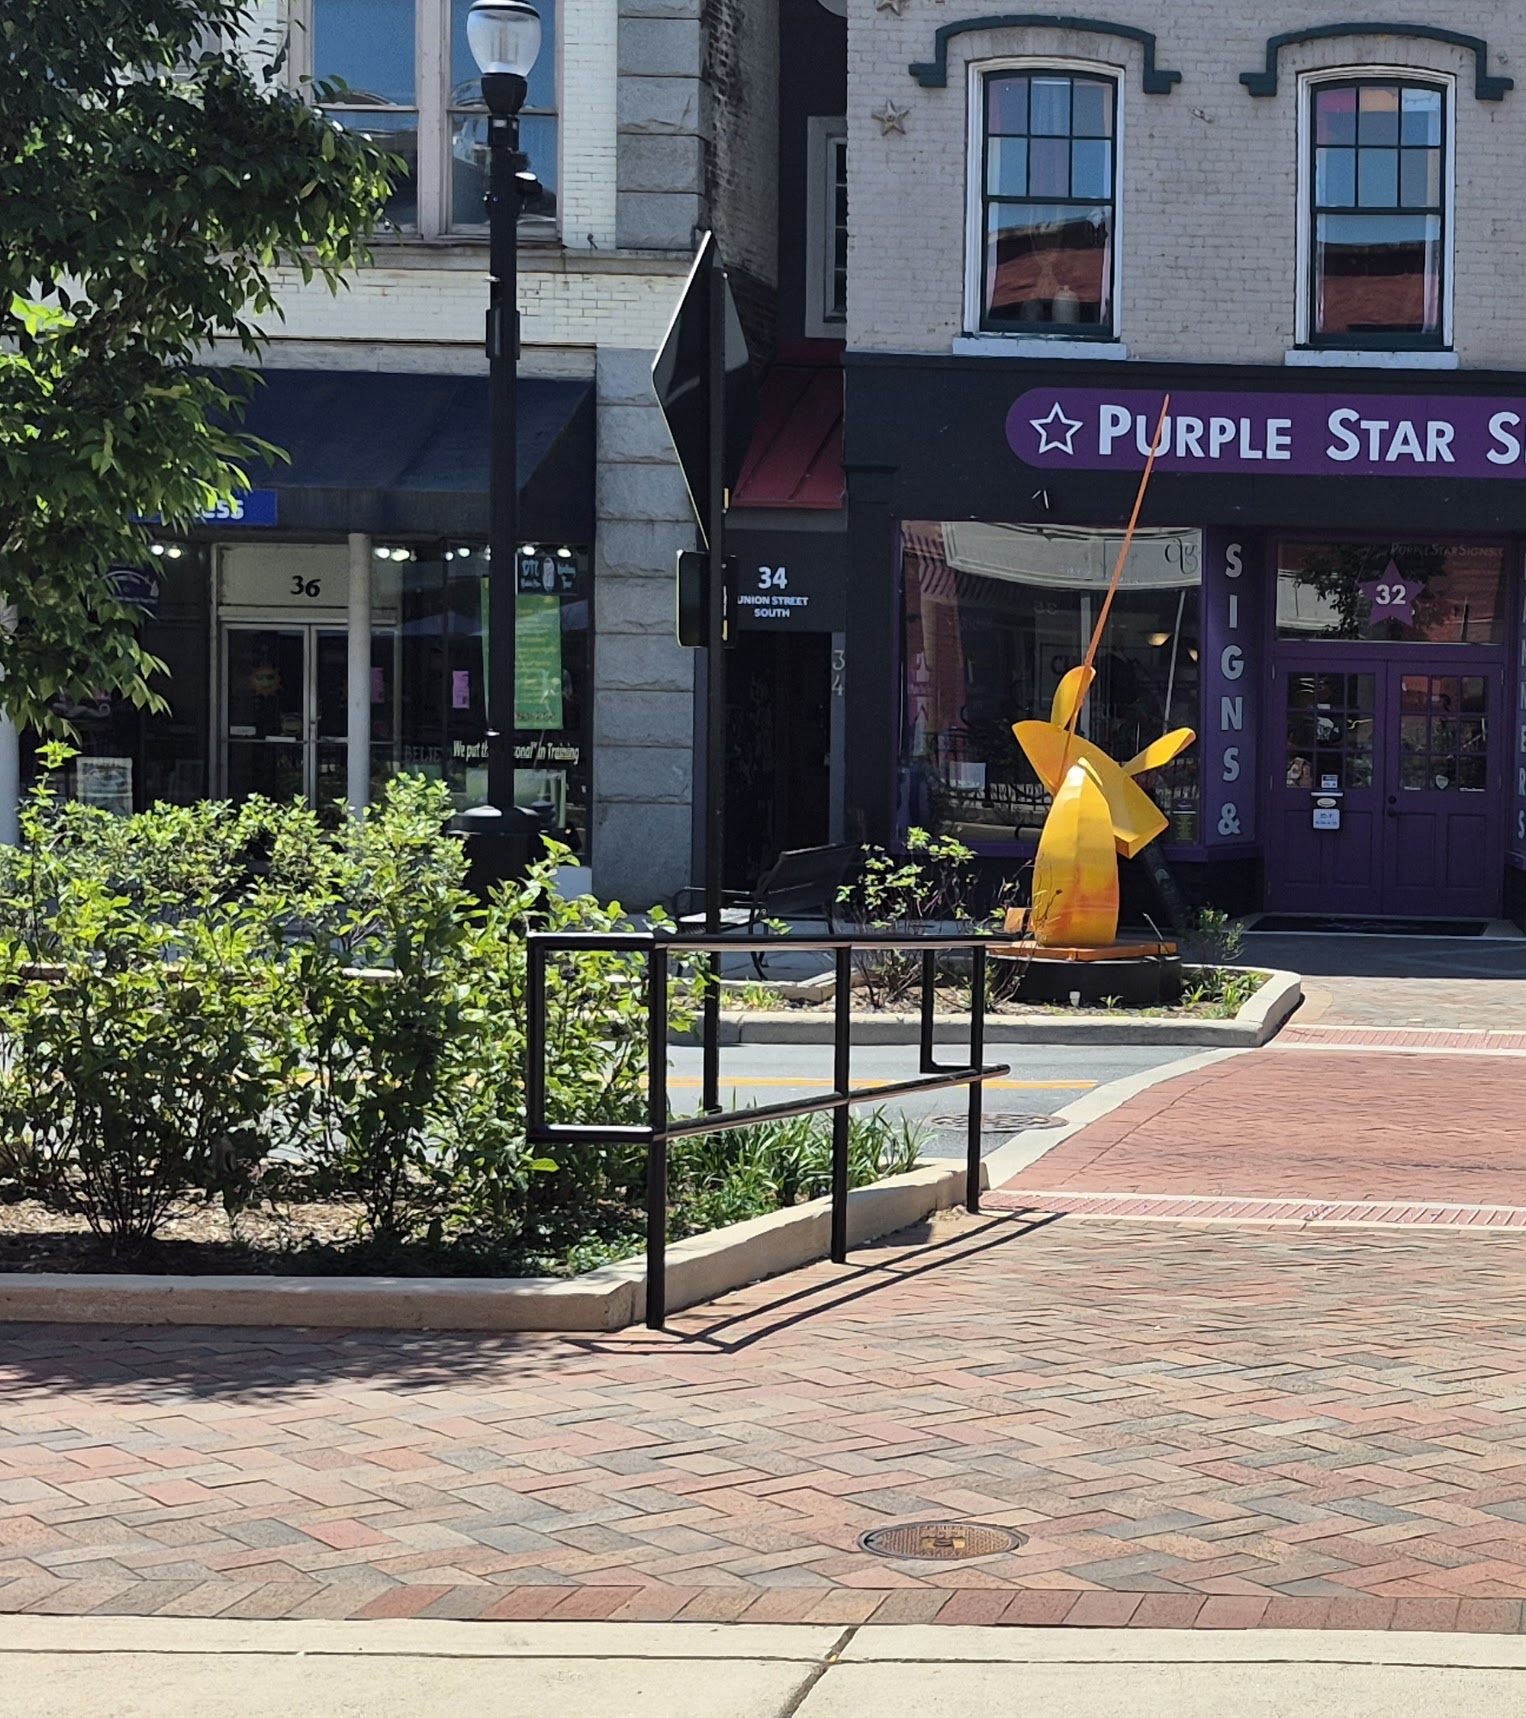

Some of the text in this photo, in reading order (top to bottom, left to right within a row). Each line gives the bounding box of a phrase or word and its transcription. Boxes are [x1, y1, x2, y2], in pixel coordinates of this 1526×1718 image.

[1099, 404, 1292, 460] PURPLE
[1326, 408, 1456, 463] STAR
[290, 575, 321, 598] 36
[758, 566, 788, 590] 34
[737, 595, 809, 606] UNION STREET
[1375, 584, 1407, 605] 32
[754, 608, 790, 618] SOUTH
[1217, 543, 1245, 836] SIGNS &
